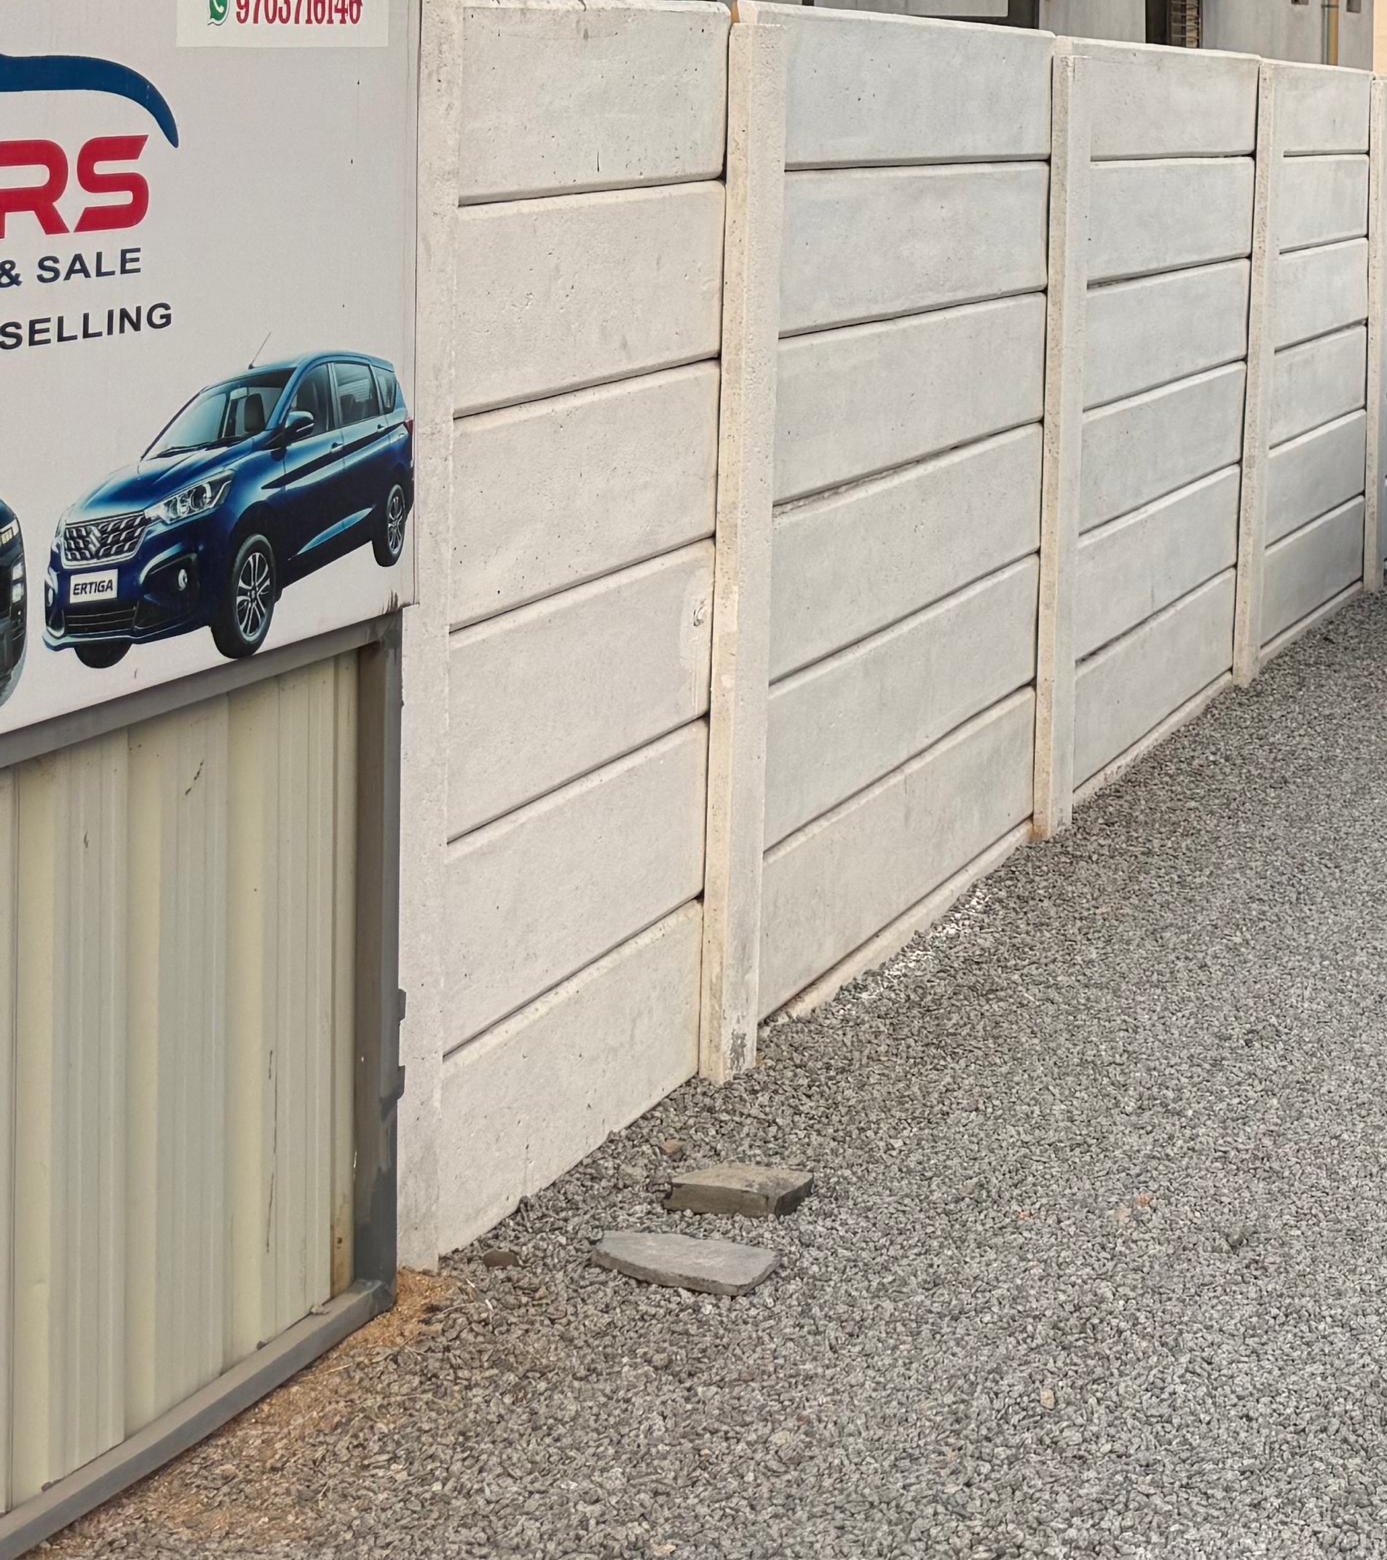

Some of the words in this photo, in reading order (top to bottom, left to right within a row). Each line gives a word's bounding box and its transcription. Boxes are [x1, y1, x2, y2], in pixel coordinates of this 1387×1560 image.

[0, 259, 23, 289] &
[36, 247, 142, 284] SALE
[0, 302, 172, 351] SELLING
[72, 579, 114, 596] ERTIGA
